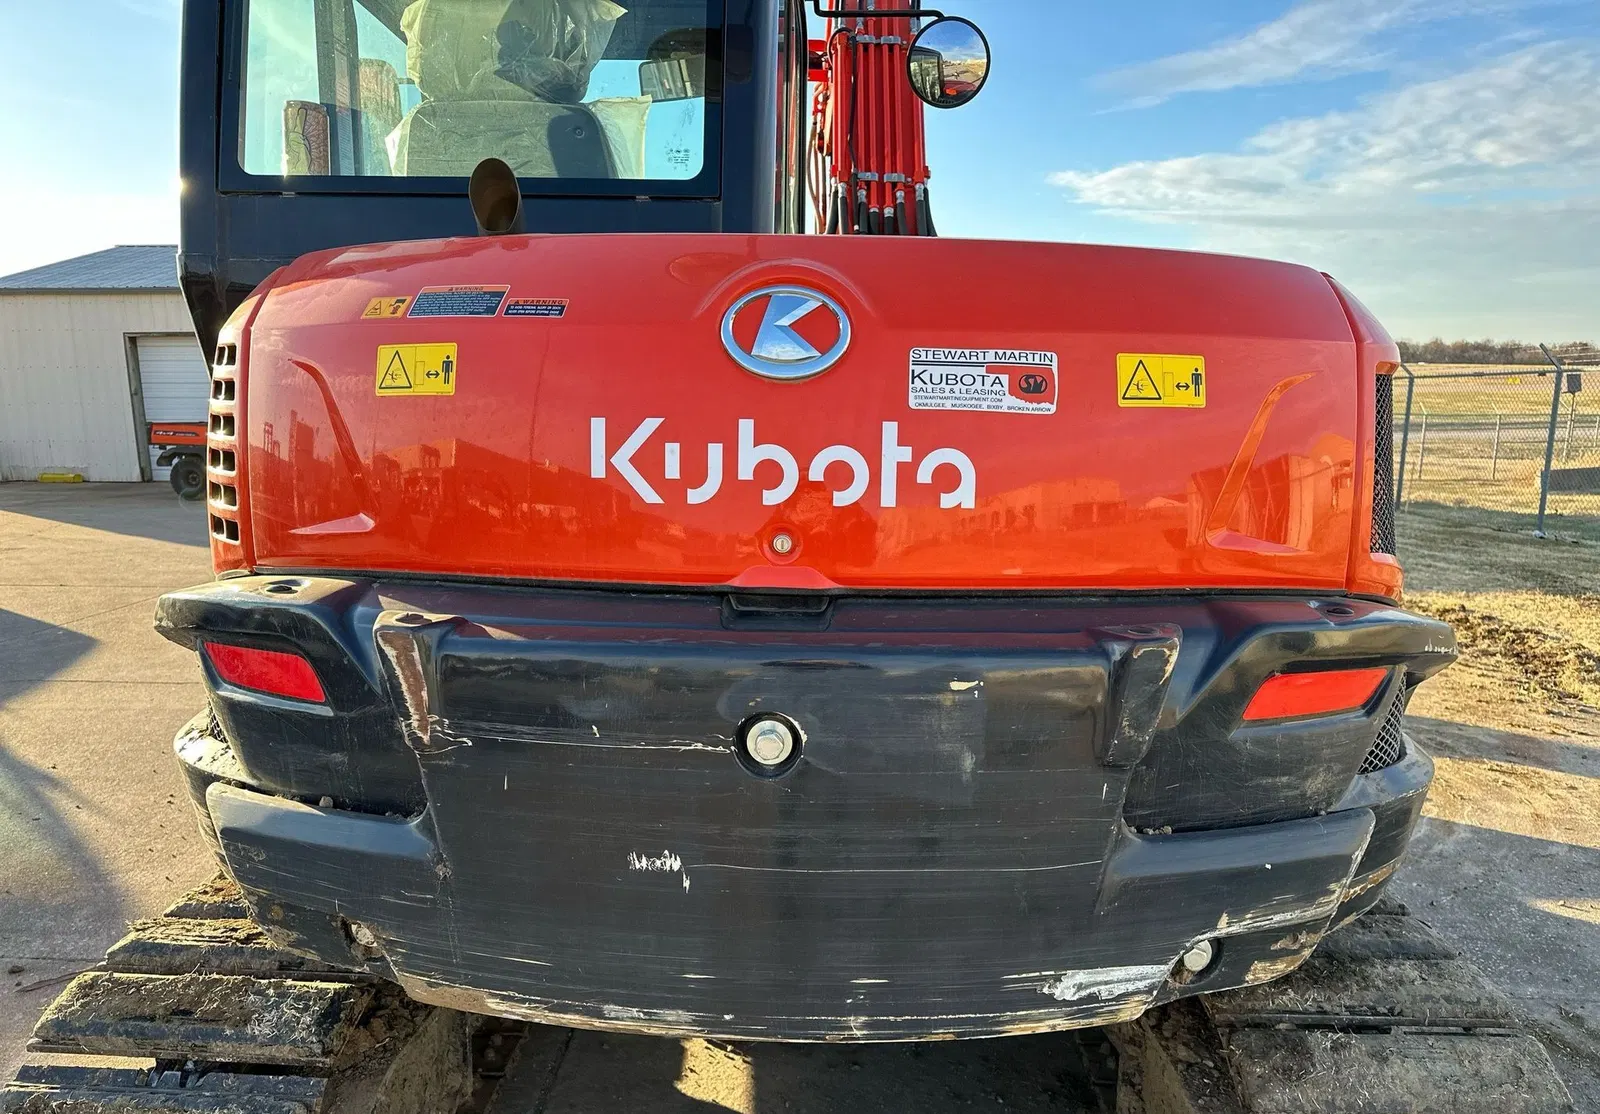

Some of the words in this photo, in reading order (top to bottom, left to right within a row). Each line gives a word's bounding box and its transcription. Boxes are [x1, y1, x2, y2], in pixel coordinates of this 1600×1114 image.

[911, 348, 989, 361] STEWART
[994, 351, 1053, 363] MARTIN
[911, 369, 1005, 388] KUBOTA
[911, 386, 946, 394] SALES
[949, 387, 956, 395] &
[959, 387, 1006, 397] LEASING
[913, 394, 1003, 403] STEWARTMARTINEQUIPMENT.COM
[590, 416, 977, 509] Kubota
